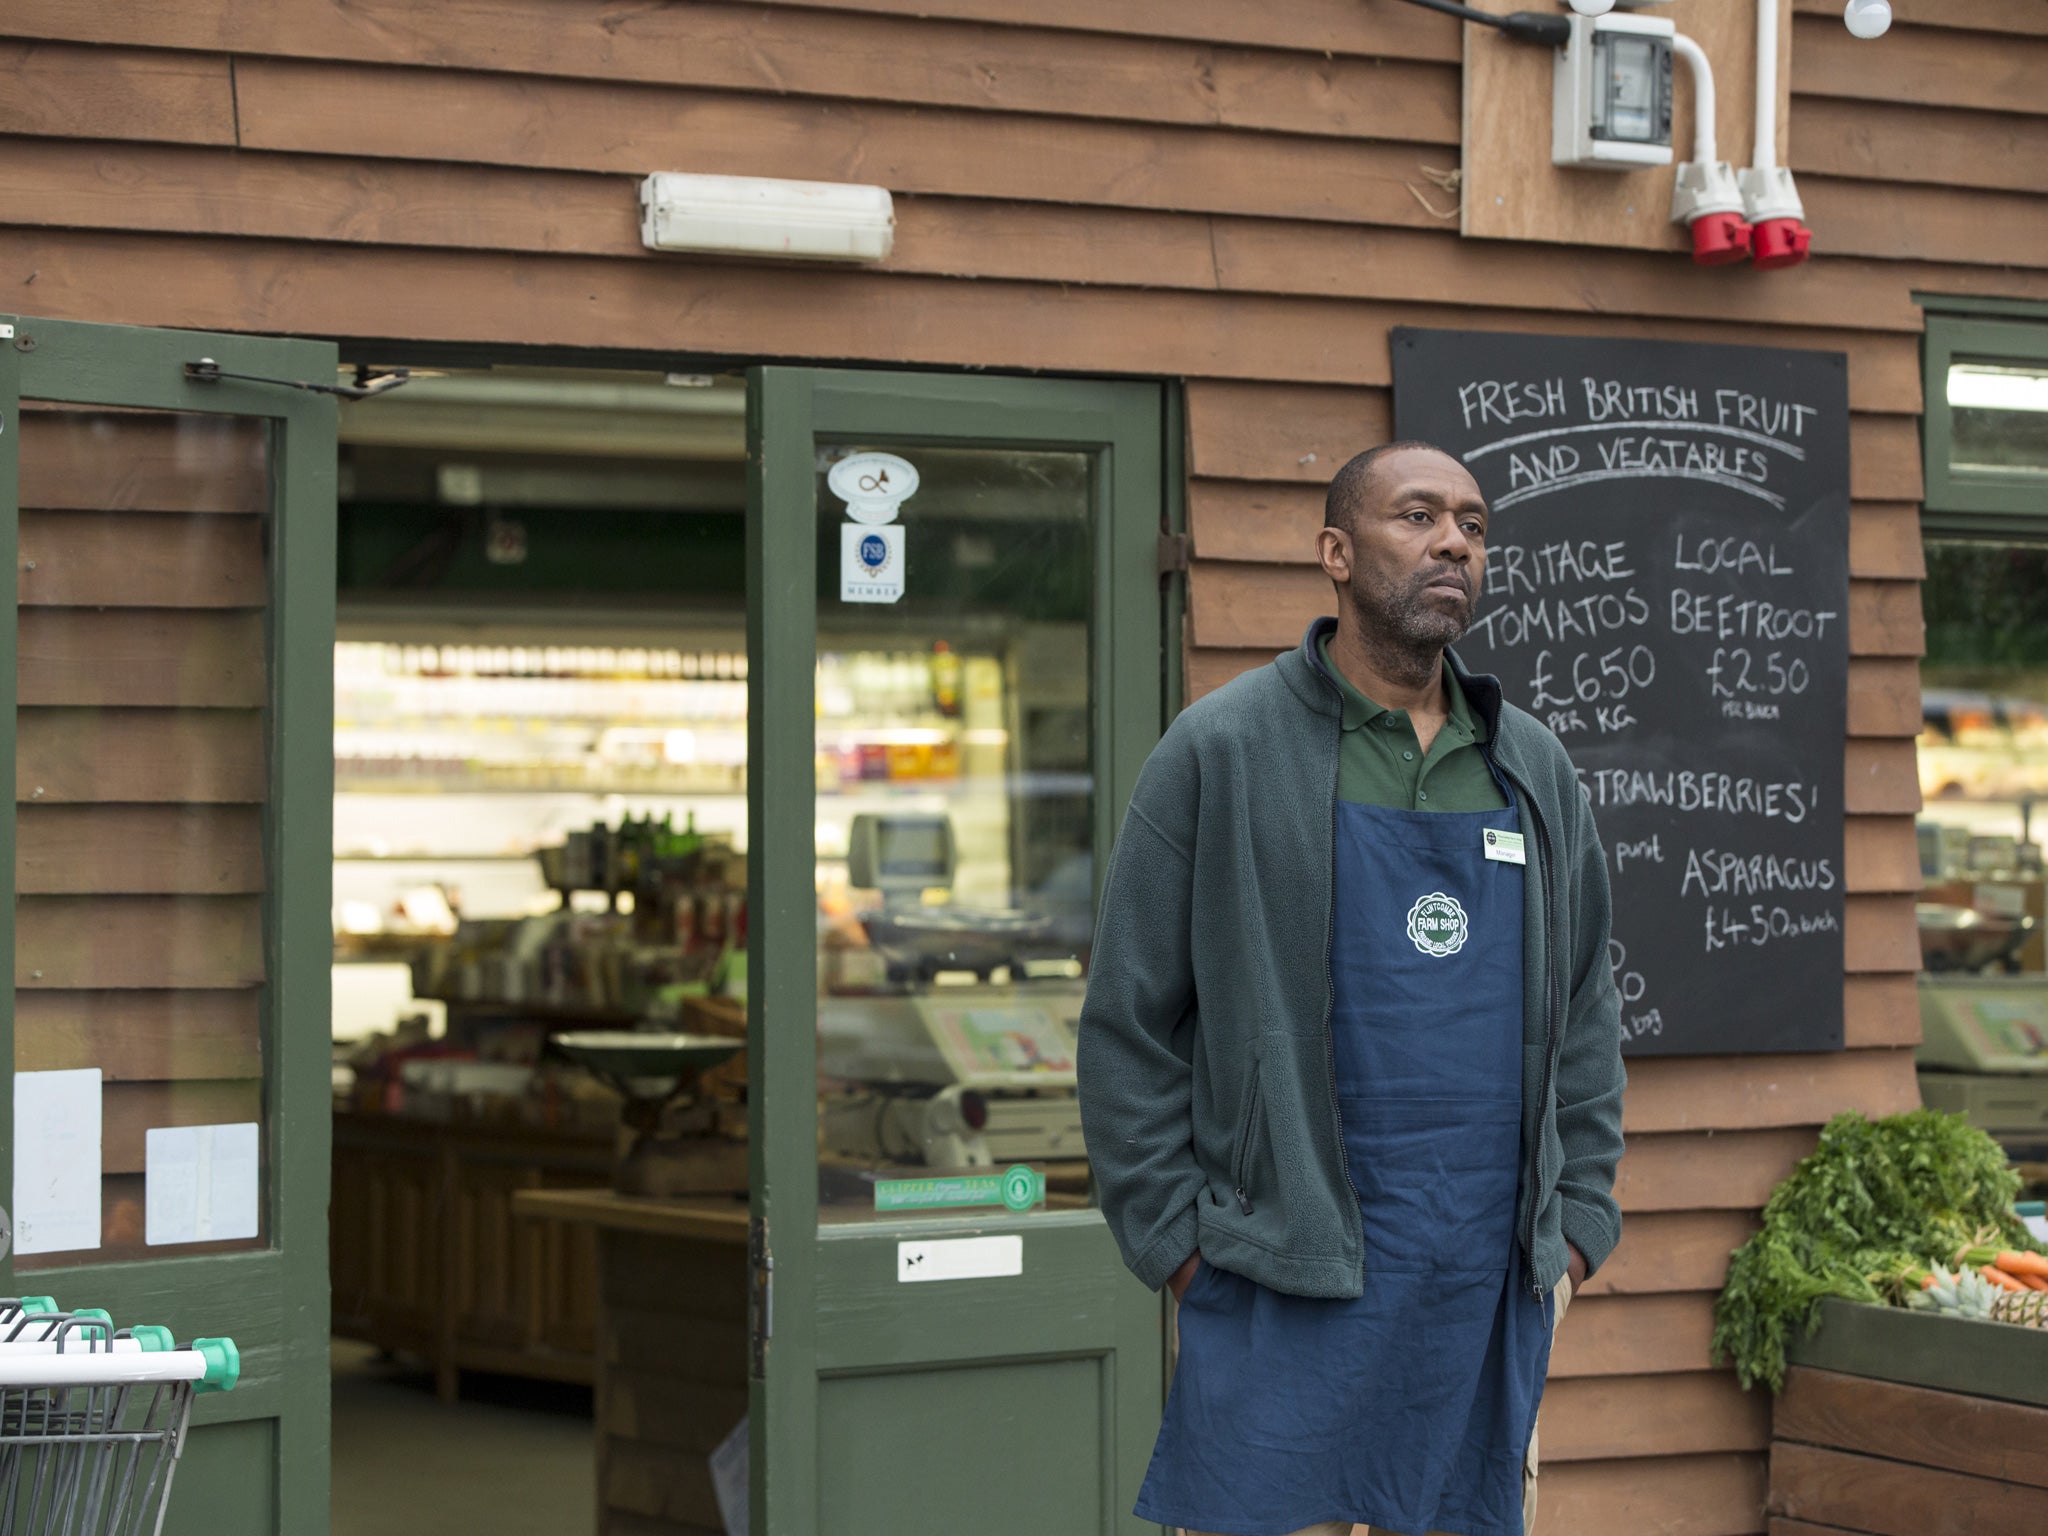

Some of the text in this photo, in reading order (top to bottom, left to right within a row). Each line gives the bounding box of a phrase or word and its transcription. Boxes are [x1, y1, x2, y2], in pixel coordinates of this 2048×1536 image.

[1458, 376, 1818, 436] FRESH BRITISH FRUIT
[1508, 436, 1768, 487] AND VEGTABLES
[1485, 540, 1636, 596] ERITAGE
[1674, 534, 1794, 576] LOCAL
[847, 586, 898, 596] MEMBER
[1670, 587, 1838, 641] BEETROOT
[1468, 587, 1650, 651] TOMATOS
[1528, 644, 1656, 710] £6.50
[1705, 647, 1809, 698] £2.50
[1547, 703, 1638, 734] PER KG
[1680, 848, 1836, 898] ASPARAGUS
[1417, 917, 1460, 931] FARM SHOP
[1705, 904, 1790, 952] £4.50
[881, 1181, 936, 1194] CLIPPER
[964, 1178, 996, 1190] TEAS
